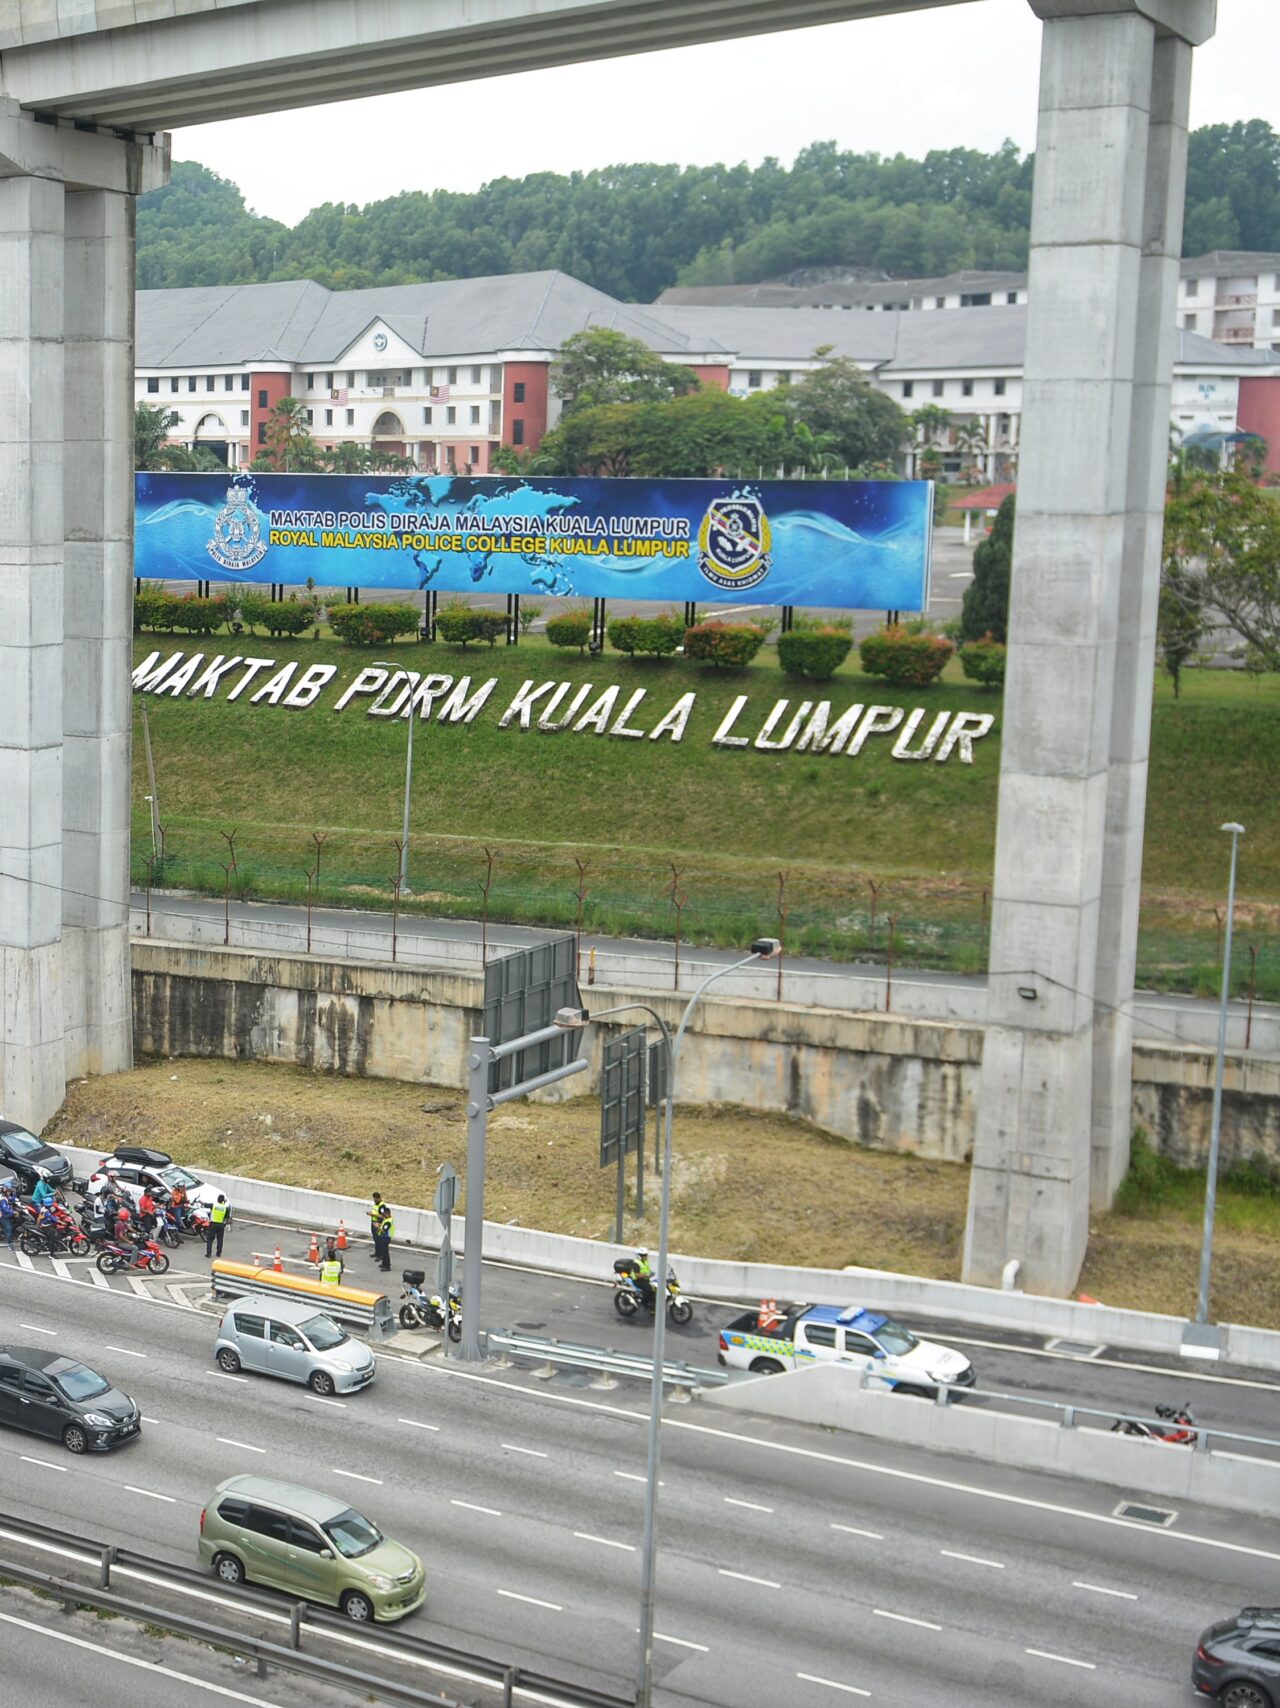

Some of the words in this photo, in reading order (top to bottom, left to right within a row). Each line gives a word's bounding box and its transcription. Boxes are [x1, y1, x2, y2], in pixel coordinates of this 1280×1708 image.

[270, 510, 336, 528] MAKTAB
[338, 513, 387, 529] POLIS
[390, 514, 451, 531] DIRAJA
[455, 515, 542, 533] MALAYSIA
[545, 517, 608, 535] KUALA
[611, 518, 689, 537] LUMPUR
[269, 530, 318, 547] ROYAL
[321, 532, 399, 549] MALAYSIA
[402, 534, 462, 551] POLICE
[465, 536, 546, 553] COLLEGE
[550, 538, 609, 555] KUALA
[613, 539, 689, 557] LUMPUR
[131, 650, 338, 708] MAKTAB
[333, 667, 499, 724] PDRM
[498, 679, 697, 742] KUALA
[711, 695, 995, 765] LUMPUR
